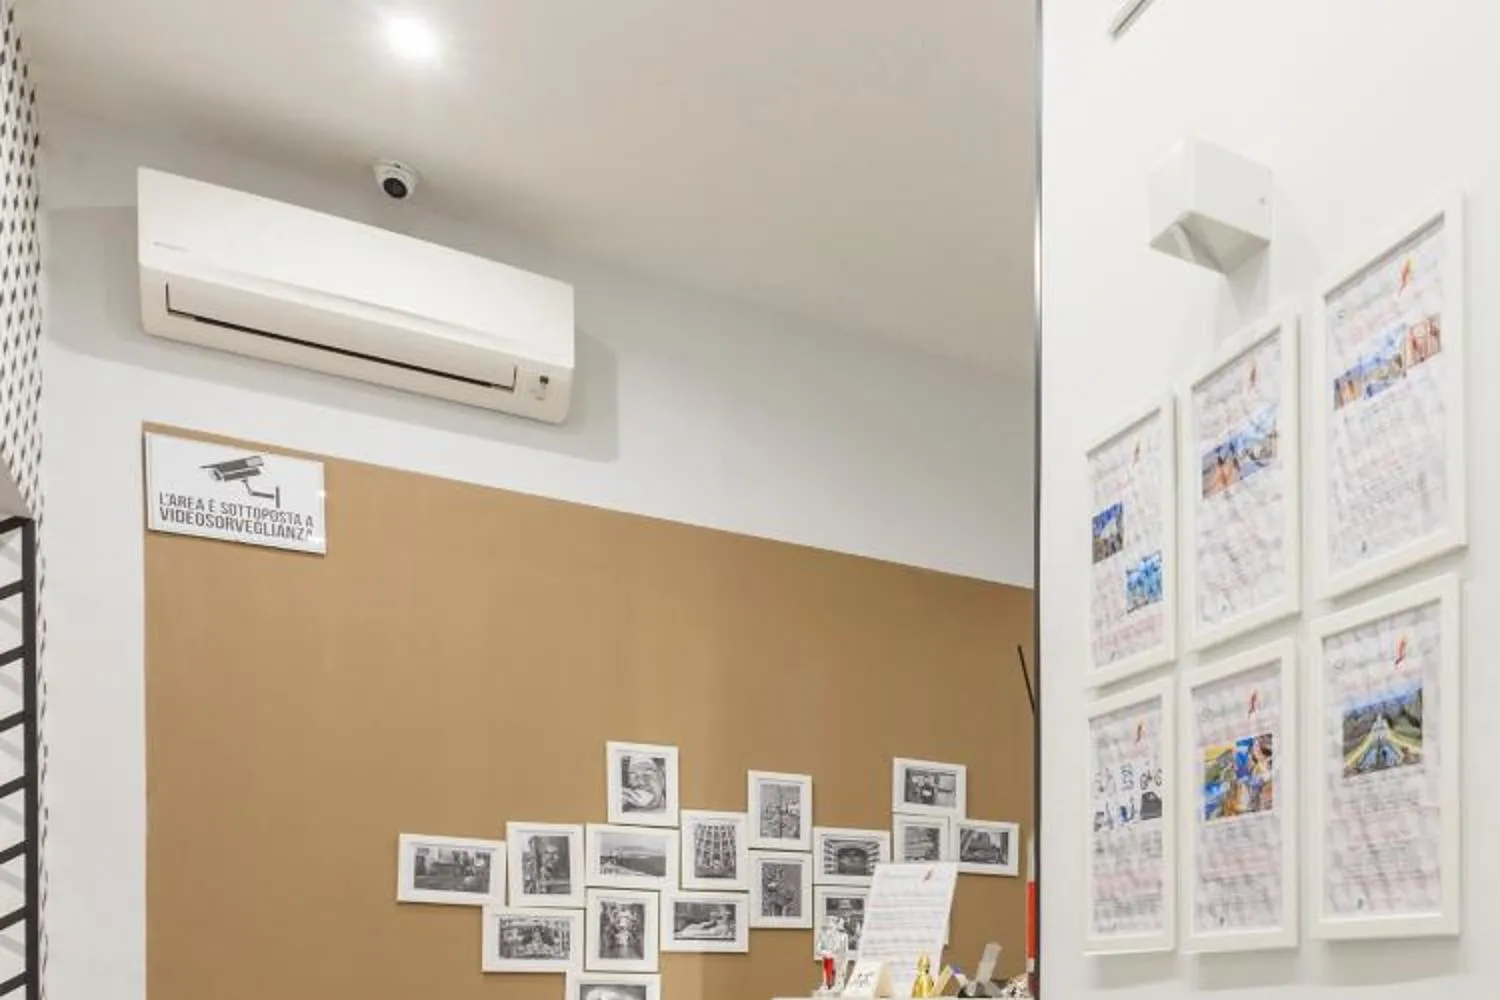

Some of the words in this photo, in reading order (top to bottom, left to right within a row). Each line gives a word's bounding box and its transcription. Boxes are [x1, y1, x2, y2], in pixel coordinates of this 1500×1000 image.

[159, 491, 205, 511] L'AREA
[220, 502, 302, 525] SOTTOPOSTA
[305, 515, 314, 528] A
